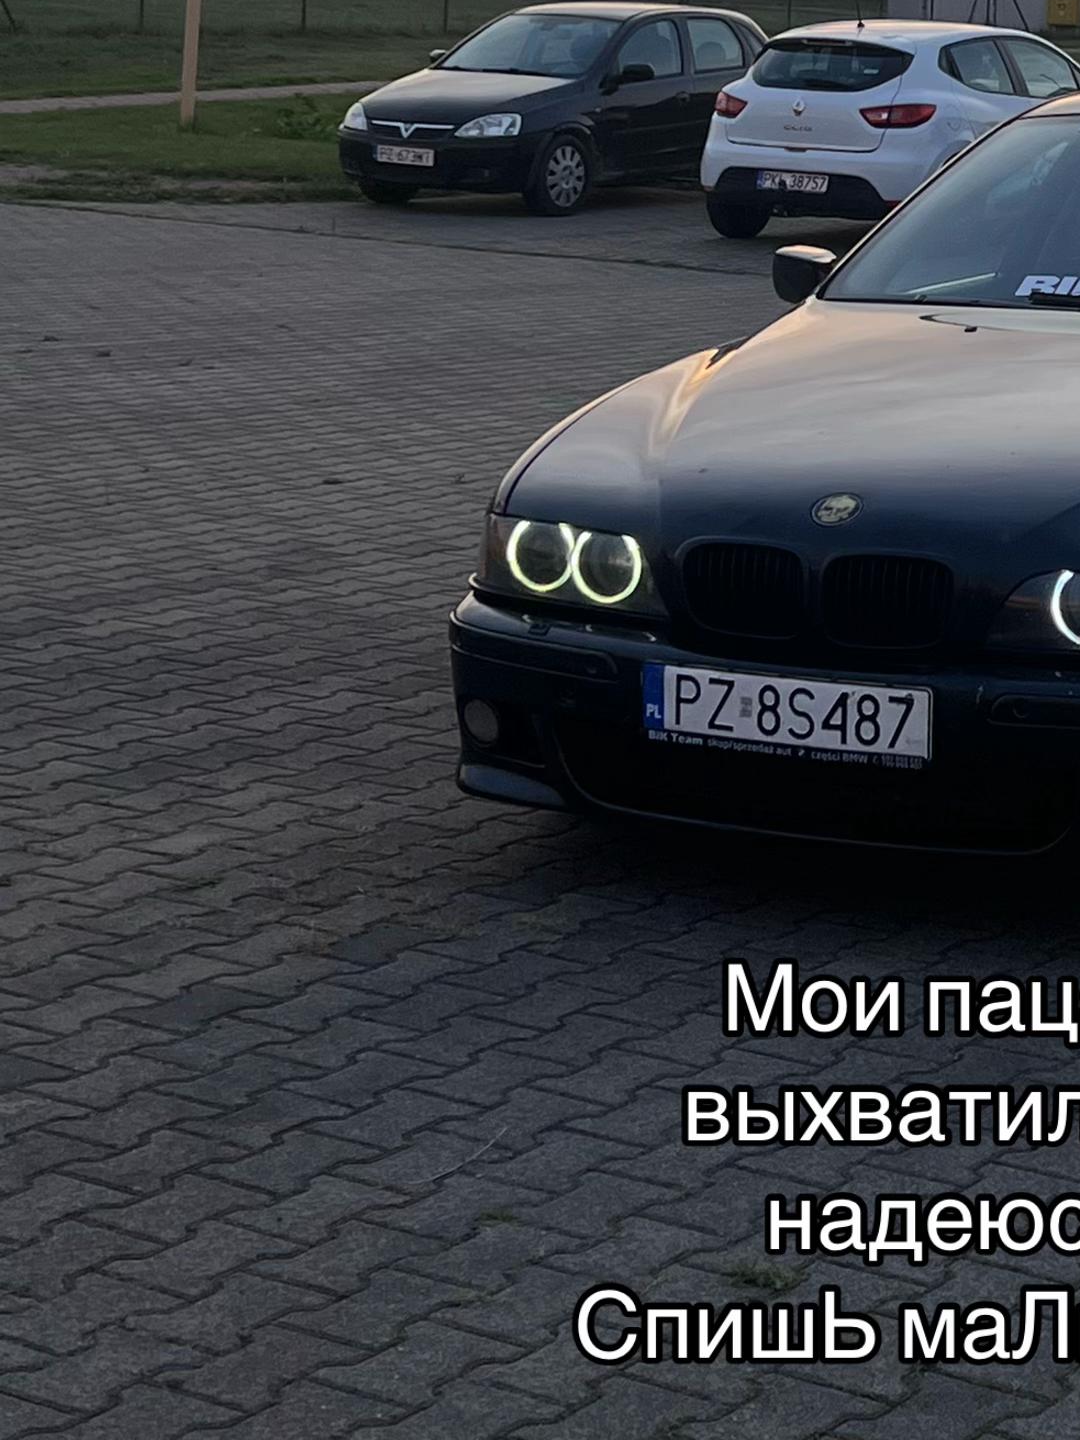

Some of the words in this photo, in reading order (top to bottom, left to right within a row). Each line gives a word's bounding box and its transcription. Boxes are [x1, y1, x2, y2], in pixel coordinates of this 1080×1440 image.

[645, 703, 663, 720] PL
[674, 673, 735, 733] PZ
[756, 684, 916, 750] 8S487
[670, 732, 704, 747] Team
[842, 752, 869, 765] BMW
